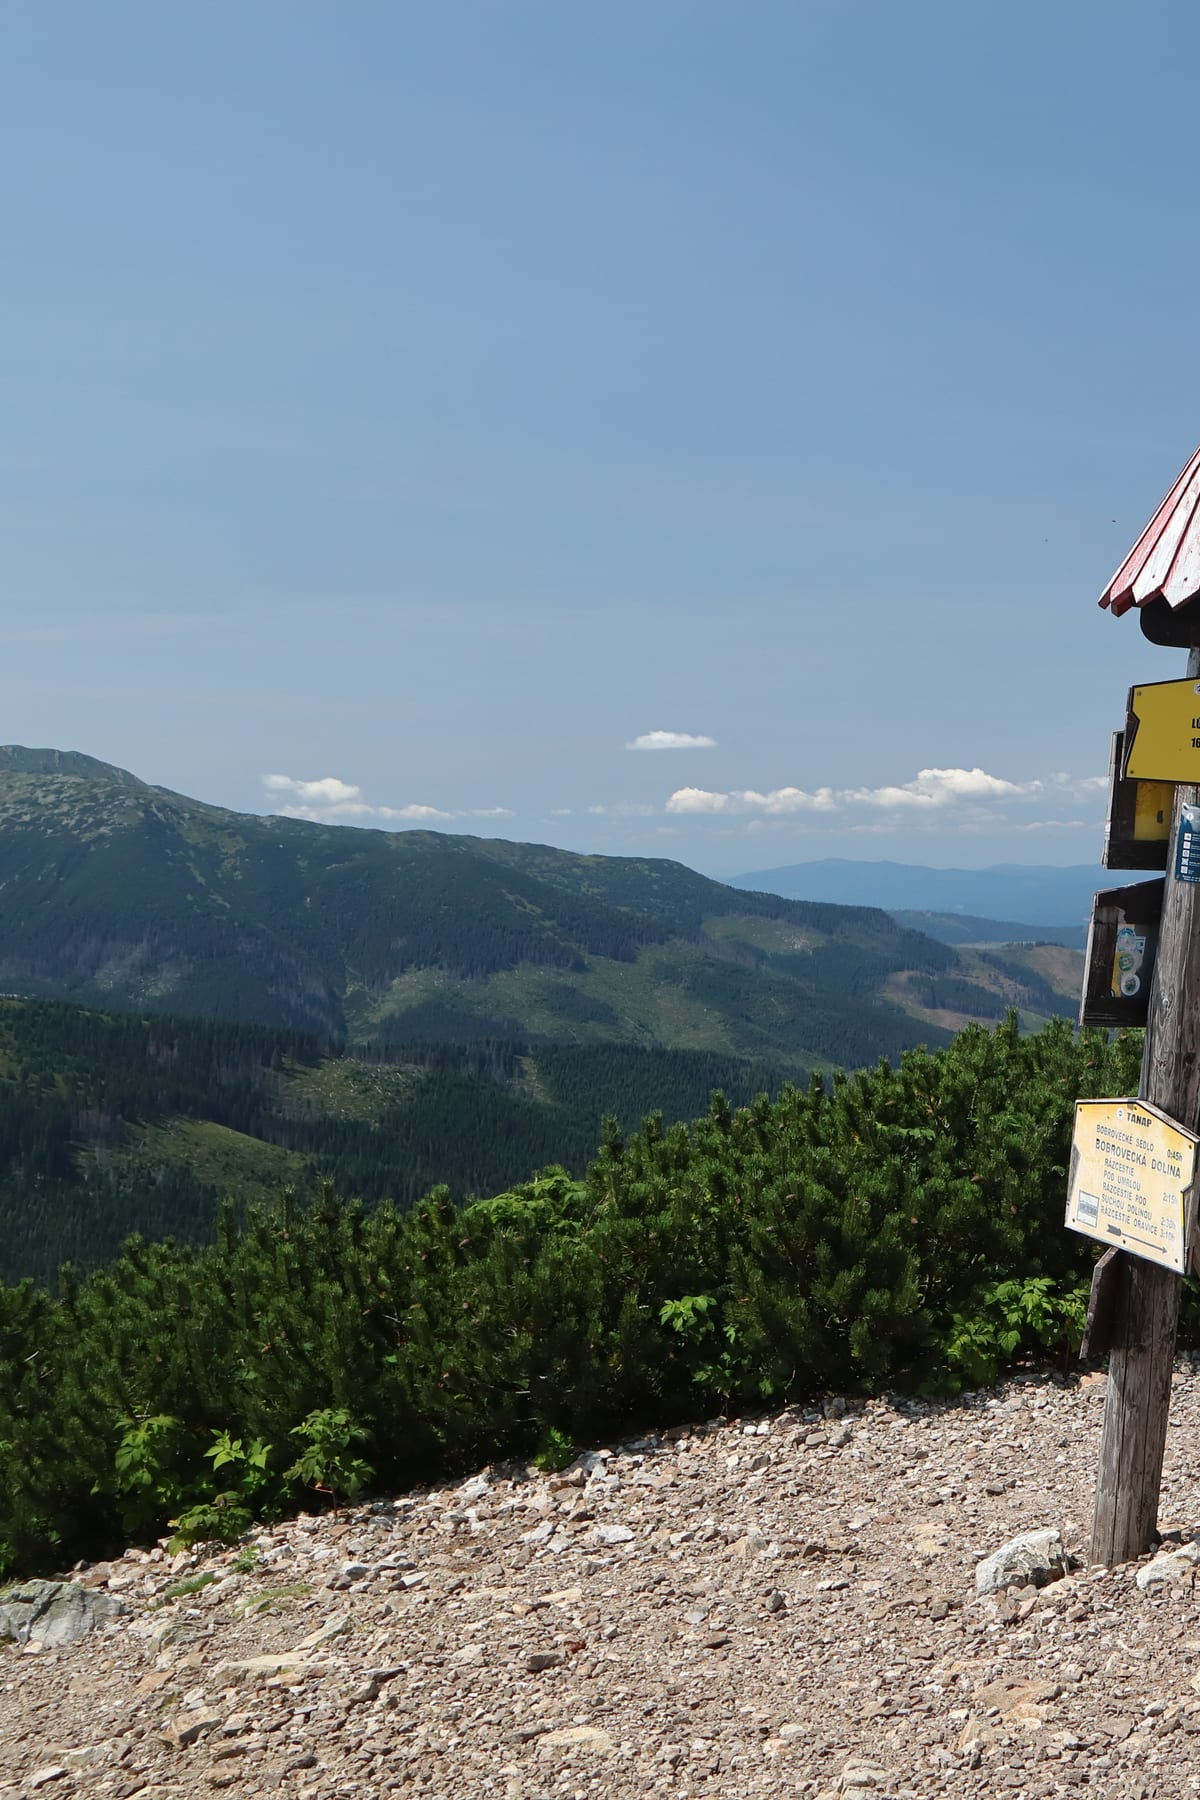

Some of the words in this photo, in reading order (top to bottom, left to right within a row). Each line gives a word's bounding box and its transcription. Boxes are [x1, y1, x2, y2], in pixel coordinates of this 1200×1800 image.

[1126, 1112, 1152, 1128] TANAP
[1096, 1138, 1147, 1167] BOBROVECKÁ
[1152, 1158, 1181, 1178] DOLINA
[1136, 1138, 1154, 1152] SEDLO
[1166, 1149, 1183, 1162] 0:45h
[1104, 1170, 1114, 1181] POD
[1102, 1193, 1124, 1210] SUCHOU
[1127, 1204, 1152, 1220] DOLINOU
[1135, 1194, 1147, 1206] POD
[1134, 1218, 1158, 1235] ORAVICE
